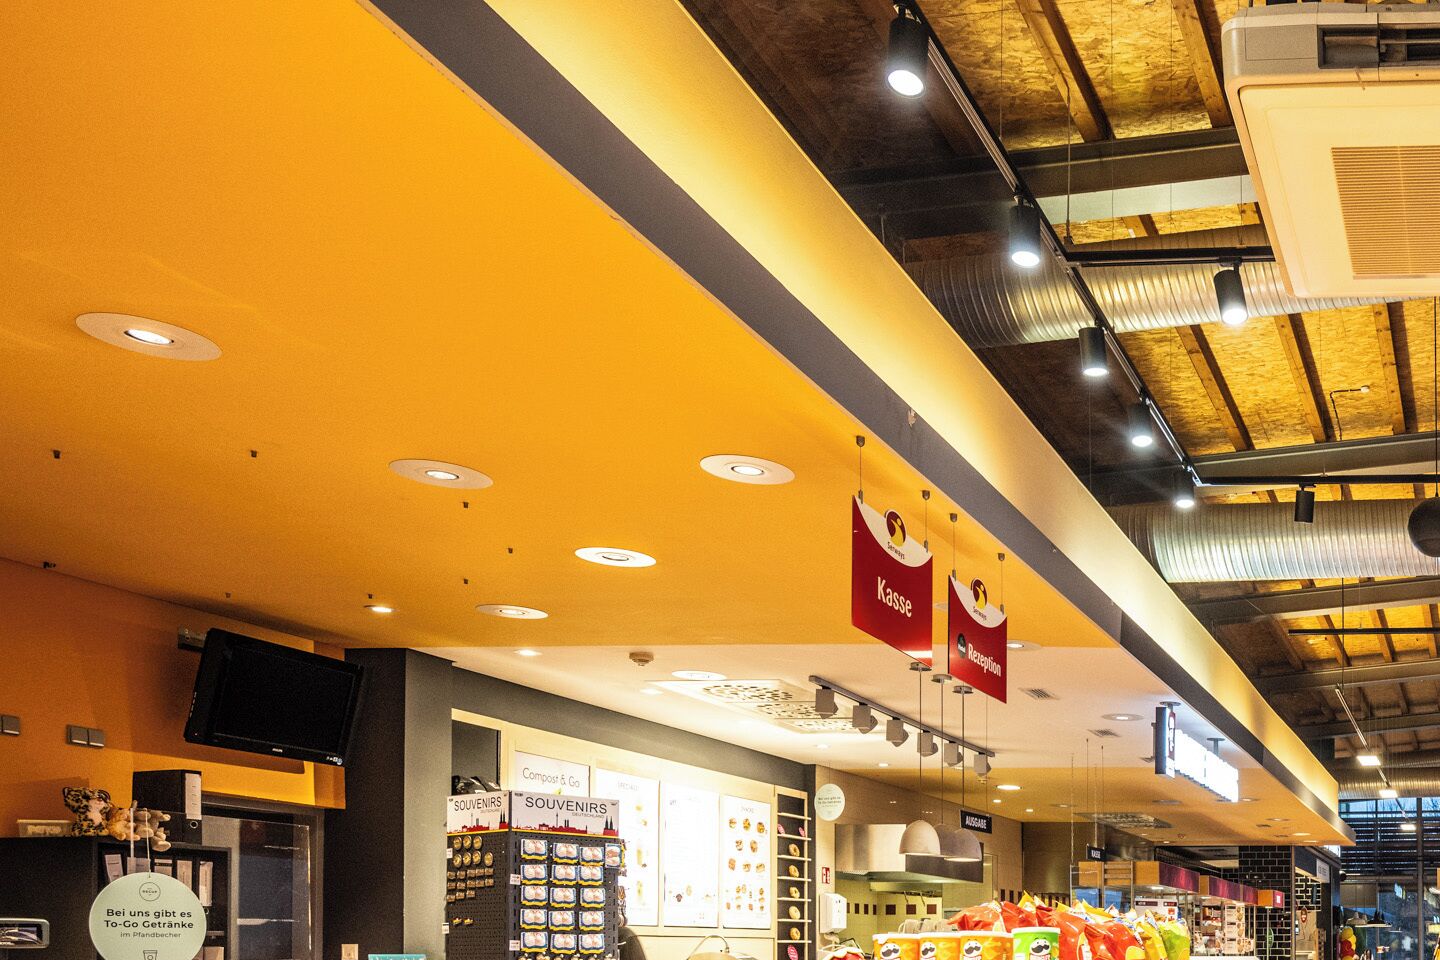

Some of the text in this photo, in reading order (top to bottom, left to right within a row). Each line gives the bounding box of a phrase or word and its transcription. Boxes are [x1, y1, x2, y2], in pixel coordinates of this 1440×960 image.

[887, 541, 905, 560] Serways
[877, 576, 912, 618] Kasse
[968, 643, 1001, 677] Rezeption
[523, 768, 580, 788] Compost & Go
[454, 796, 502, 811] SOUVENIRS
[525, 797, 607, 814] SOUVENIRS
[965, 815, 987, 829] AUSGABE
[106, 909, 125, 917] Bei
[154, 910, 176, 919] gibt
[104, 920, 194, 929] To-Go Getränke
